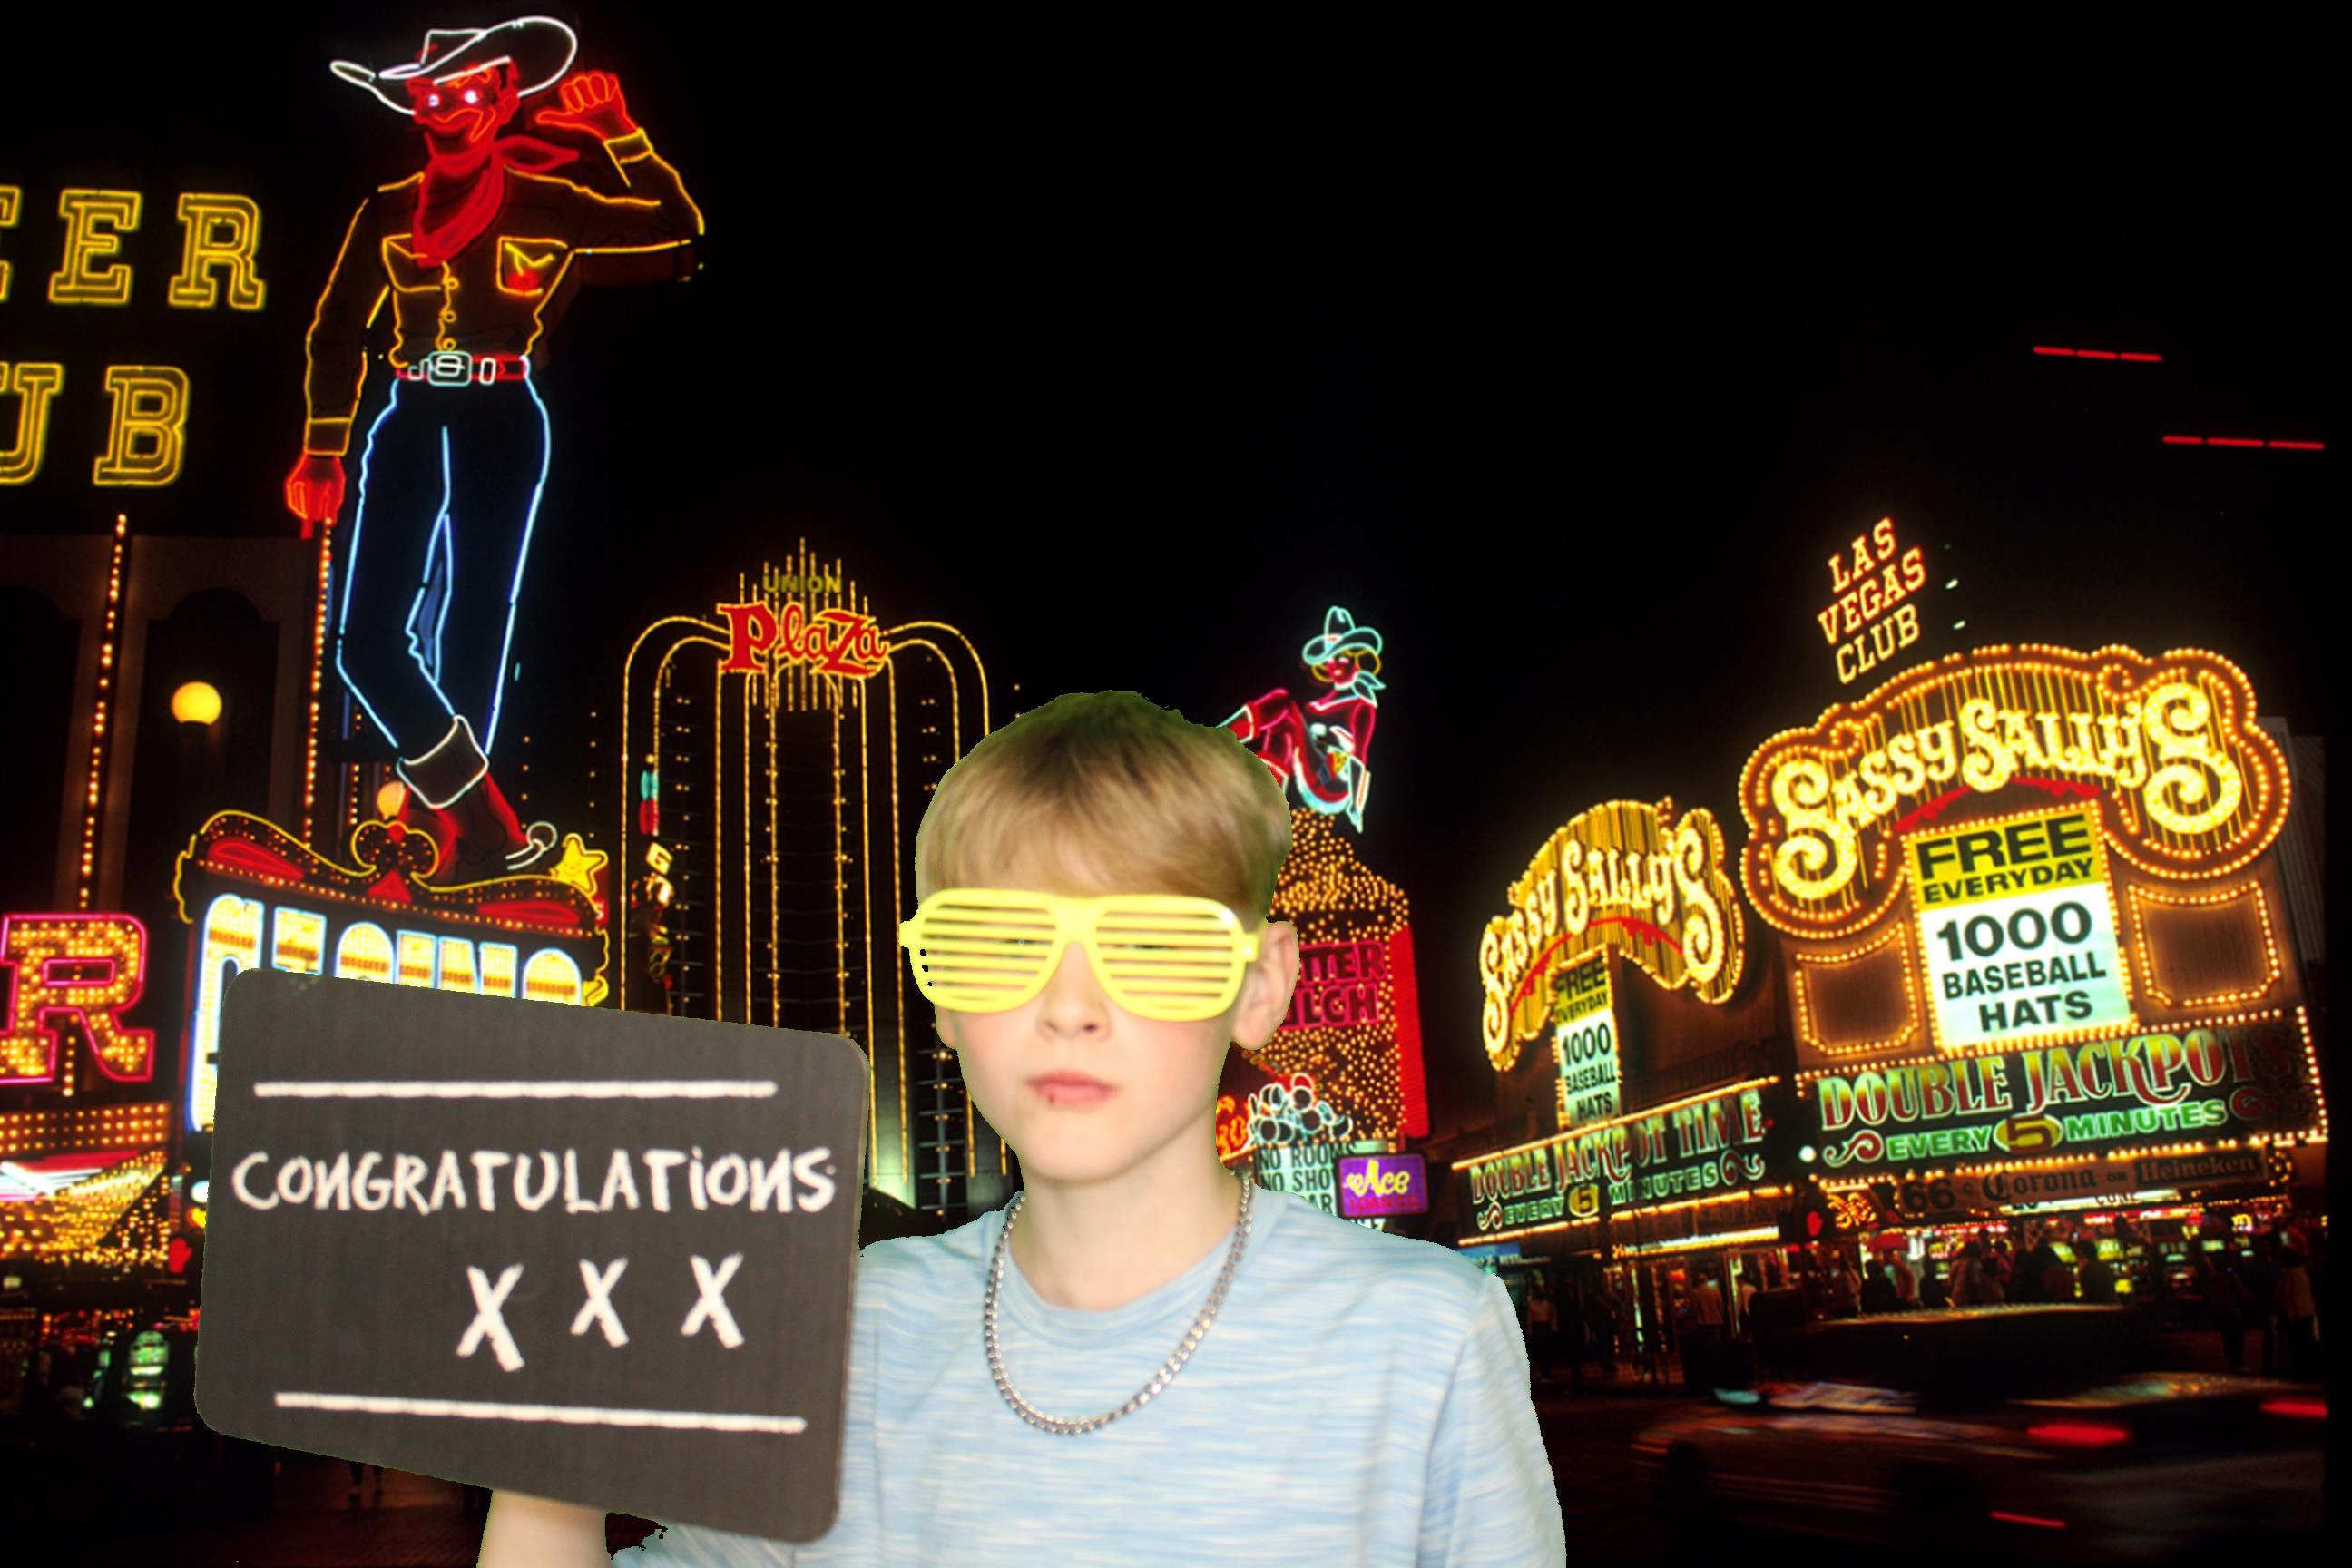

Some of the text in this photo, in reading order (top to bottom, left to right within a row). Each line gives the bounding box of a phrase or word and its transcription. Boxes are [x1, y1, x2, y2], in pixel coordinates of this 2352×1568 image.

[0, 185, 267, 310] ER
[1828, 516, 1896, 593] LAS
[763, 574, 843, 593] UNION
[1817, 546, 1926, 645] VEGAS
[1836, 603, 1920, 685] CLUB
[1916, 814, 2092, 880] FREE
[1923, 858, 2093, 904] EVERYDAY
[1936, 901, 2092, 961] 1000
[1553, 955, 1607, 999] FREE
[1942, 951, 2106, 1000] BASEBALL
[1556, 991, 1609, 1024] EVERYDAY
[1979, 990, 2092, 1031] HATS
[1563, 1022, 1612, 1066] 1000
[1564, 1061, 1616, 1095] BASEBALL
[1817, 1054, 2014, 1131] DOUBLE
[1577, 1091, 1612, 1122] HATS
[1886, 1099, 2228, 1160] EVERY 5 MINUTES
[1259, 1147, 1282, 1170] NO
[1469, 1144, 1552, 1206] DOUBLE
[1672, 1087, 1766, 1159] TIME
[231, 1145, 837, 1216] CONGRATULATIONS
[1292, 1168, 1334, 1191] SHO
[1504, 1196, 1565, 1225] EVERY
[1608, 1161, 1720, 1206] MINUTES
[1982, 1168, 2097, 1202] Corona
[2140, 1154, 2257, 1183] Heineken
